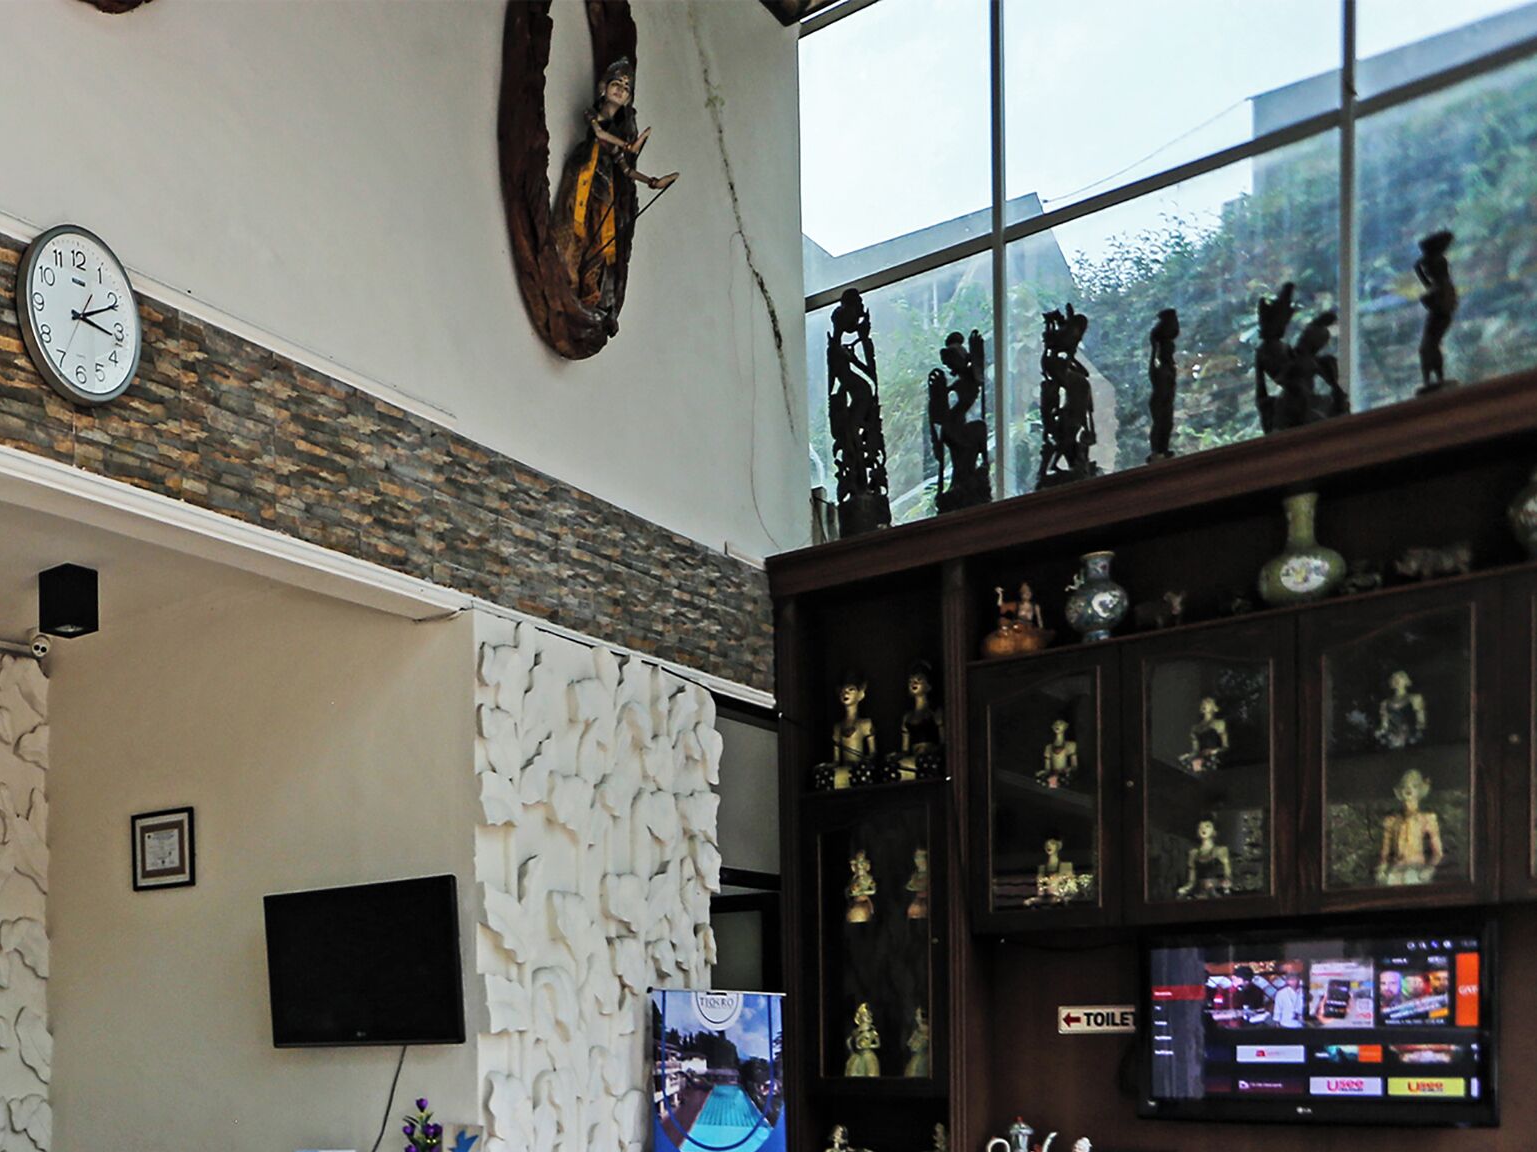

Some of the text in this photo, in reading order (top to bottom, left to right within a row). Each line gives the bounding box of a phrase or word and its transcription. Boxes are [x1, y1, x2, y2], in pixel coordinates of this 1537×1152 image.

[53, 249, 62, 268] 11
[71, 250, 86, 271] 12
[39, 265, 55, 286] 10
[33, 292, 44, 311] 9
[107, 292, 119, 311] 2
[40, 324, 52, 343] 8
[114, 323, 125, 342] 3
[56, 349, 67, 368] 7
[108, 350, 119, 366] 4
[75, 365, 87, 384] 6
[95, 363, 105, 382] 5
